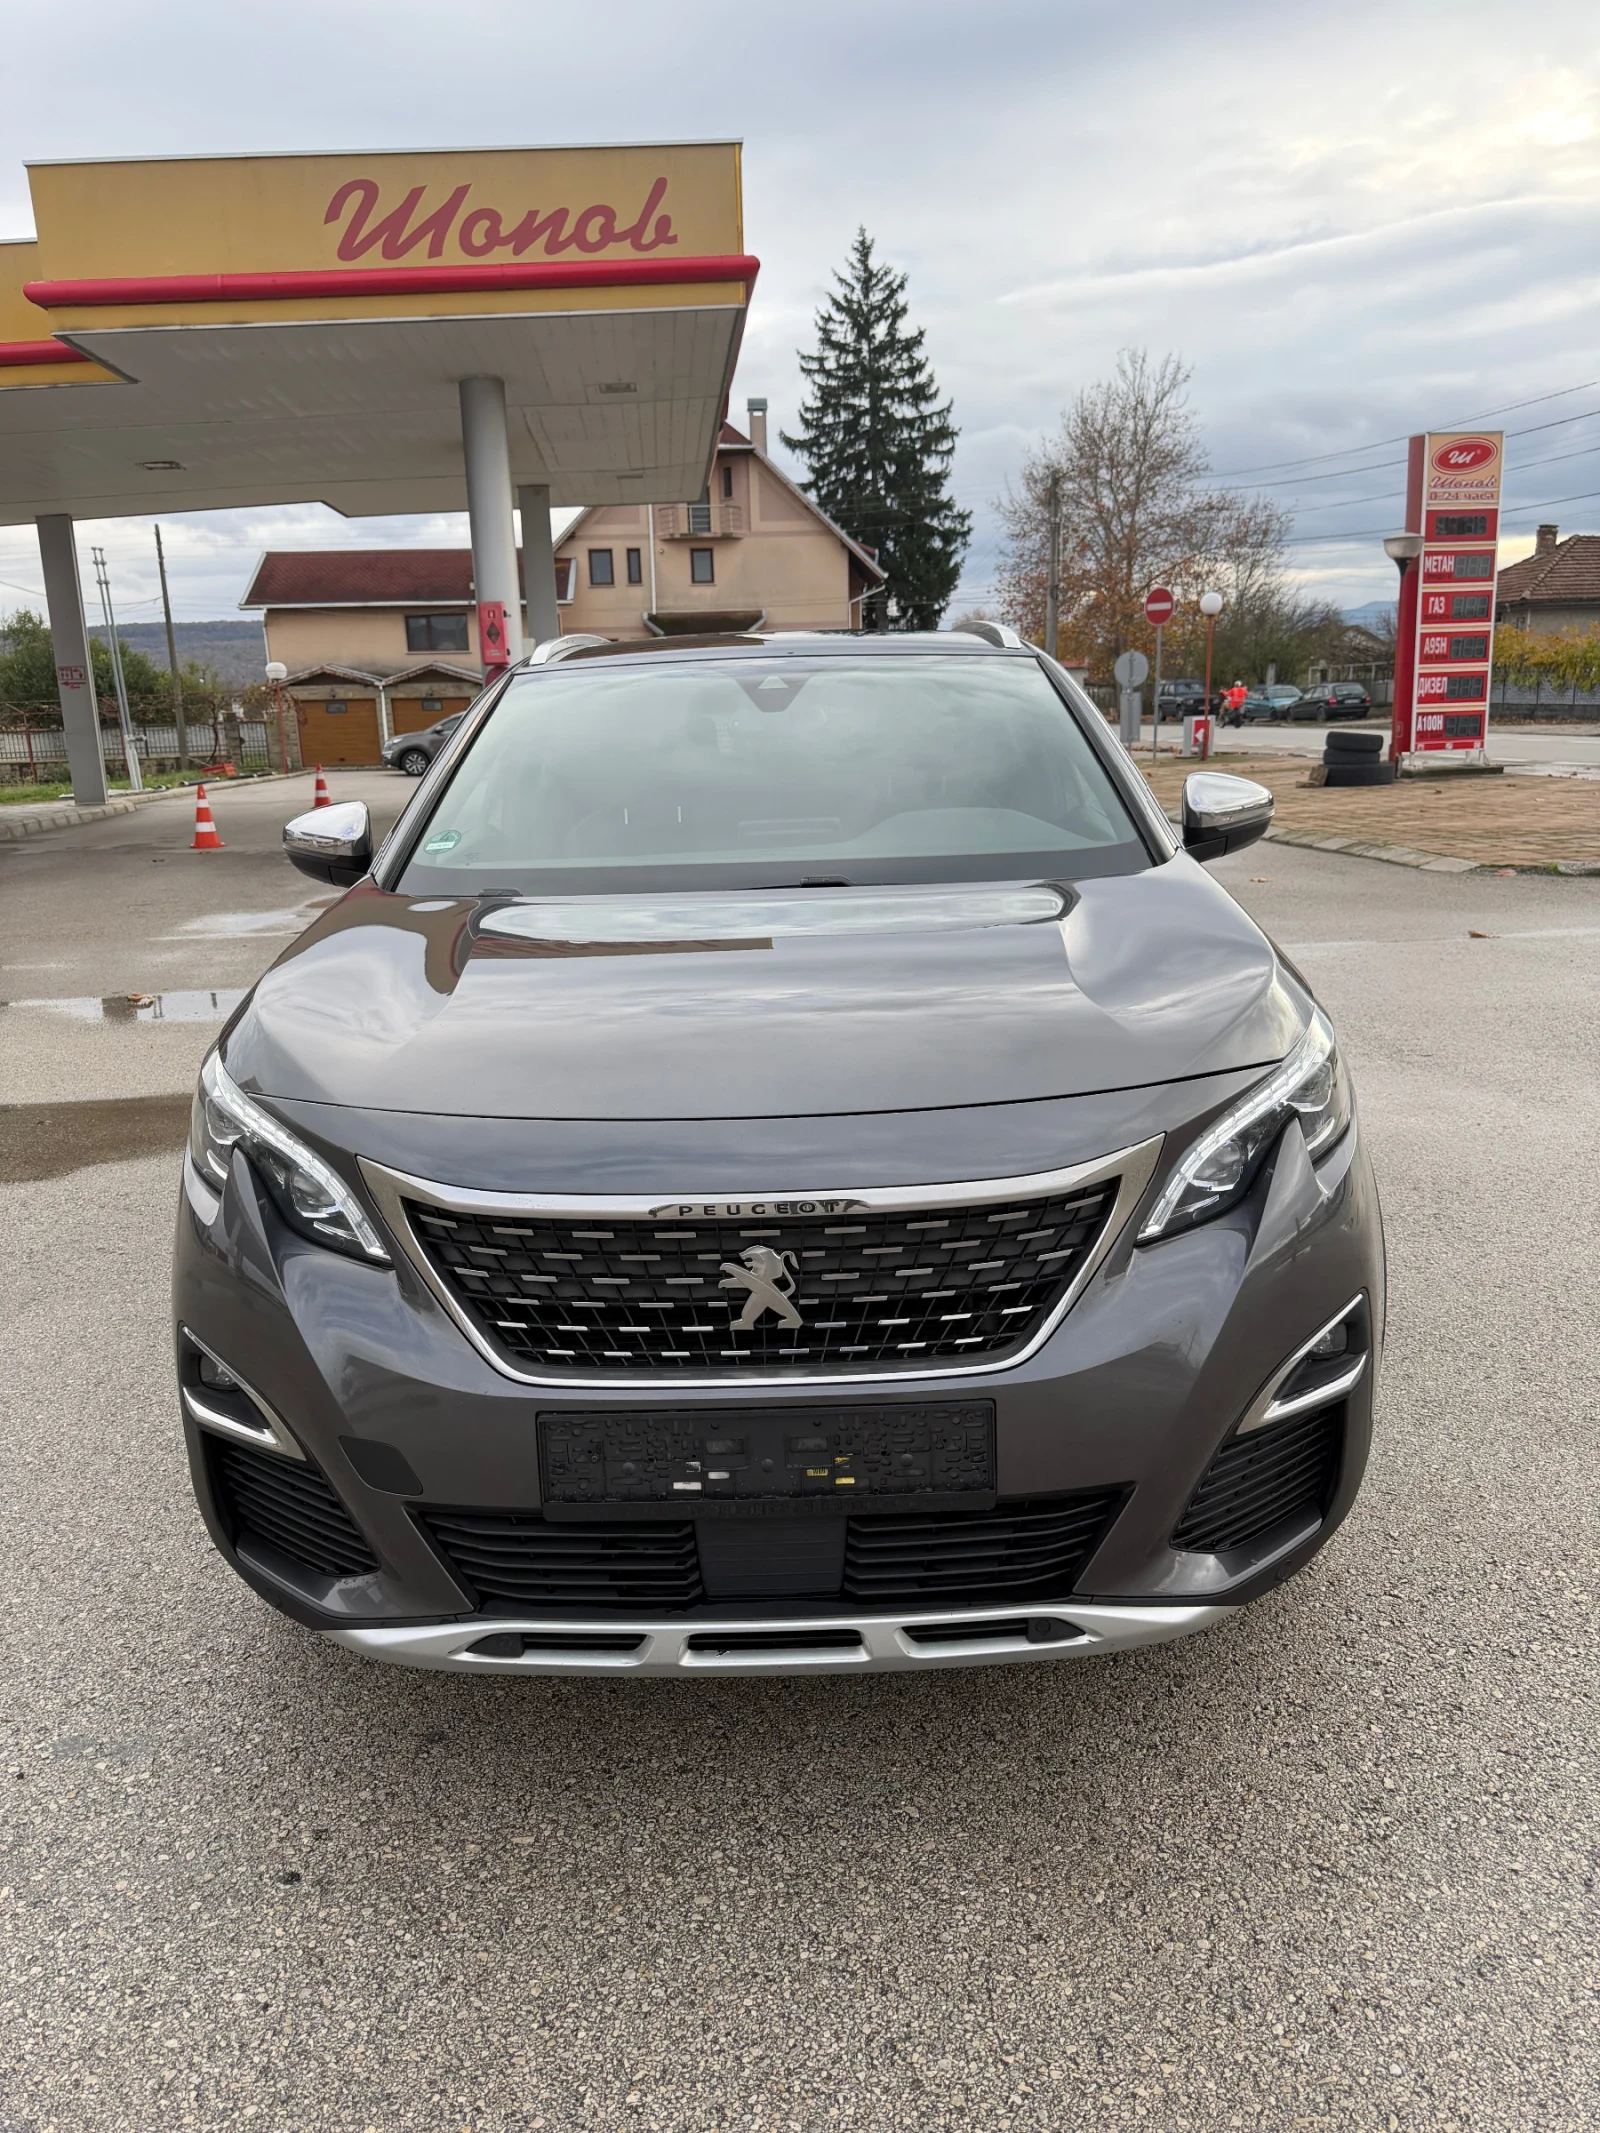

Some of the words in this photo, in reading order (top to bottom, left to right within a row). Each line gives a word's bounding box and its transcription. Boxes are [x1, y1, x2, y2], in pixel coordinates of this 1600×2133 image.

[1424, 554, 1455, 573] МЕТАН
[1428, 596, 1446, 615] ГАЗ
[1423, 636, 1448, 654] А95Н
[1417, 676, 1448, 698] ДИЗЕЛ
[1416, 714, 1444, 732] А100Н
[678, 1200, 840, 1217] PEUGEOT
